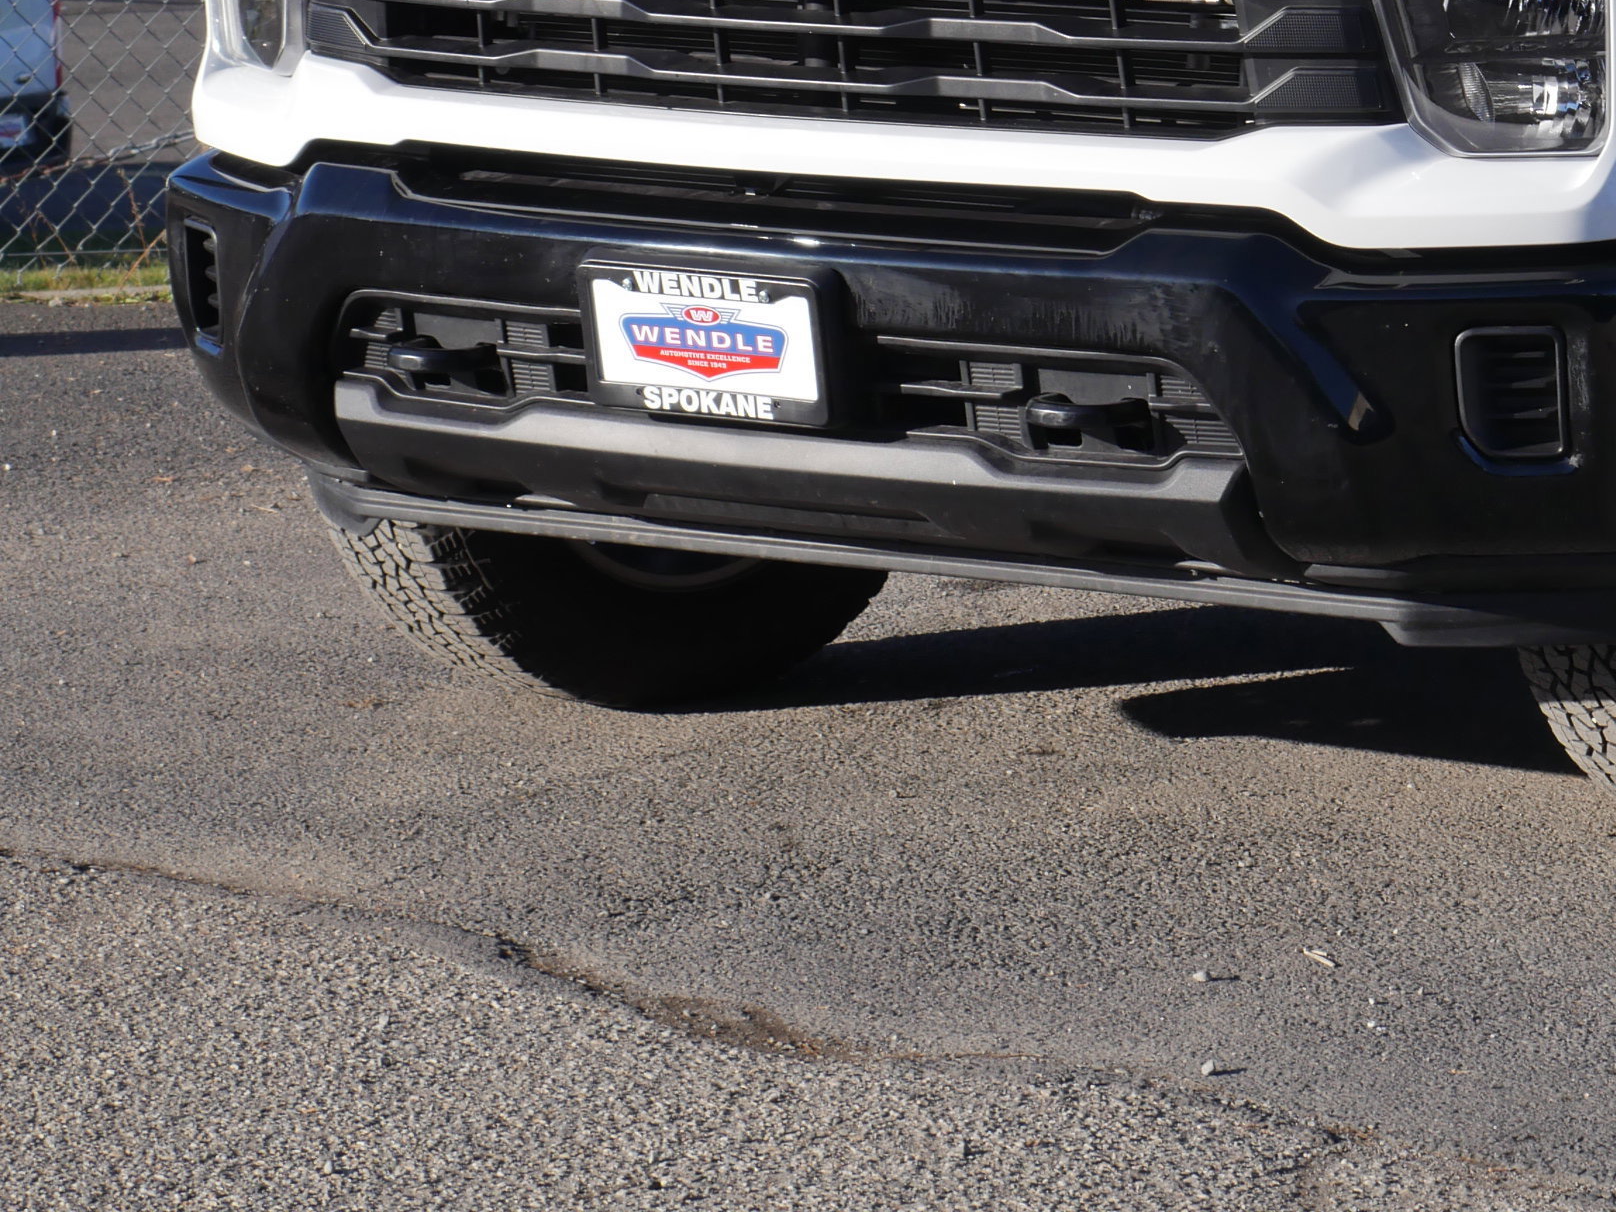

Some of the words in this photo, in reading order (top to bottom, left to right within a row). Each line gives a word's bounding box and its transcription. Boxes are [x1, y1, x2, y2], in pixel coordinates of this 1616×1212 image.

[633, 270, 760, 303] WENDLE
[630, 324, 775, 353] WENDLE
[660, 349, 705, 359] AUTOMOTIVE
[706, 353, 751, 363] EXCELLENCE
[643, 385, 775, 420] SPOKANE
